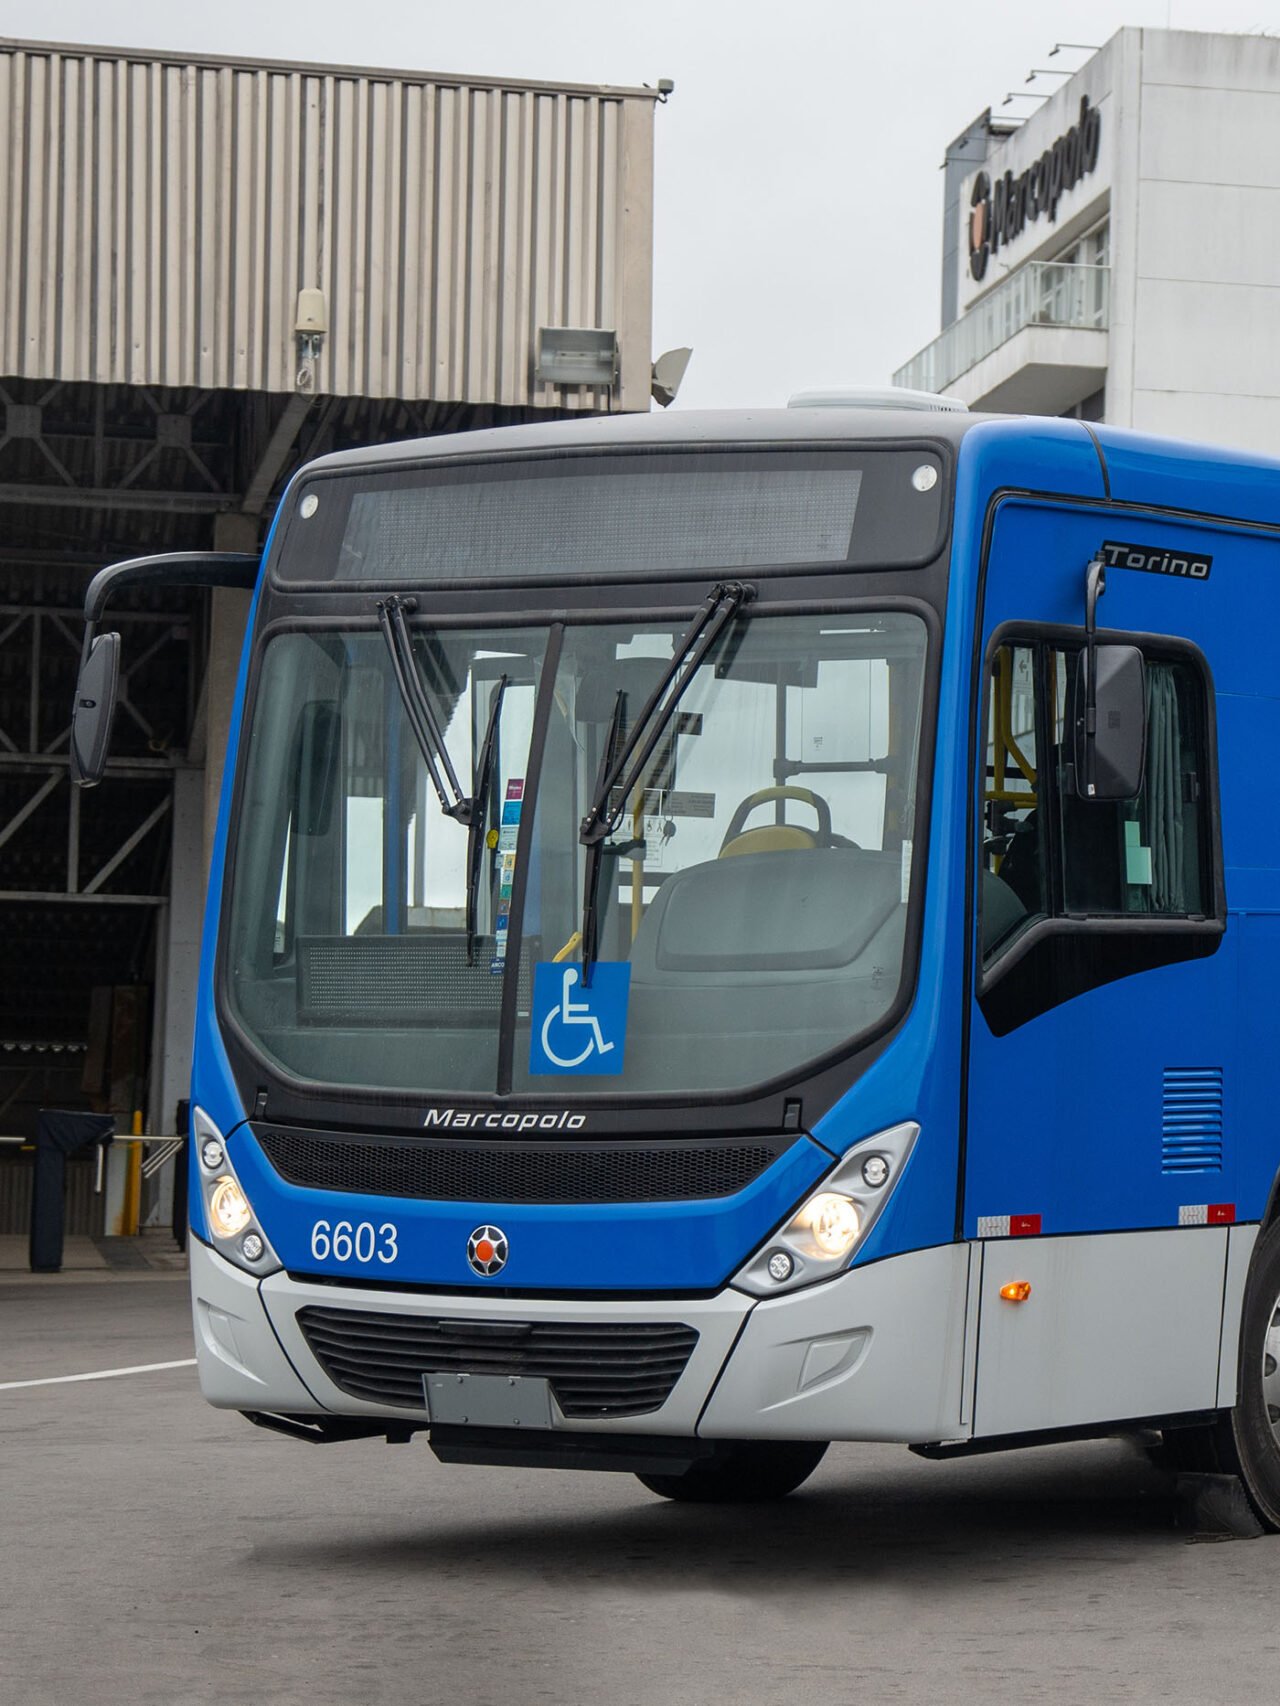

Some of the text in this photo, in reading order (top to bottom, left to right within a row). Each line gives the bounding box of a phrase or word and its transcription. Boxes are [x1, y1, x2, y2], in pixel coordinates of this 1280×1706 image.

[990, 94, 1101, 254] Marcopolo
[1104, 545, 1208, 577] Torino
[423, 1109, 587, 1132] Marcopolo
[311, 1219, 398, 1264] 6603
